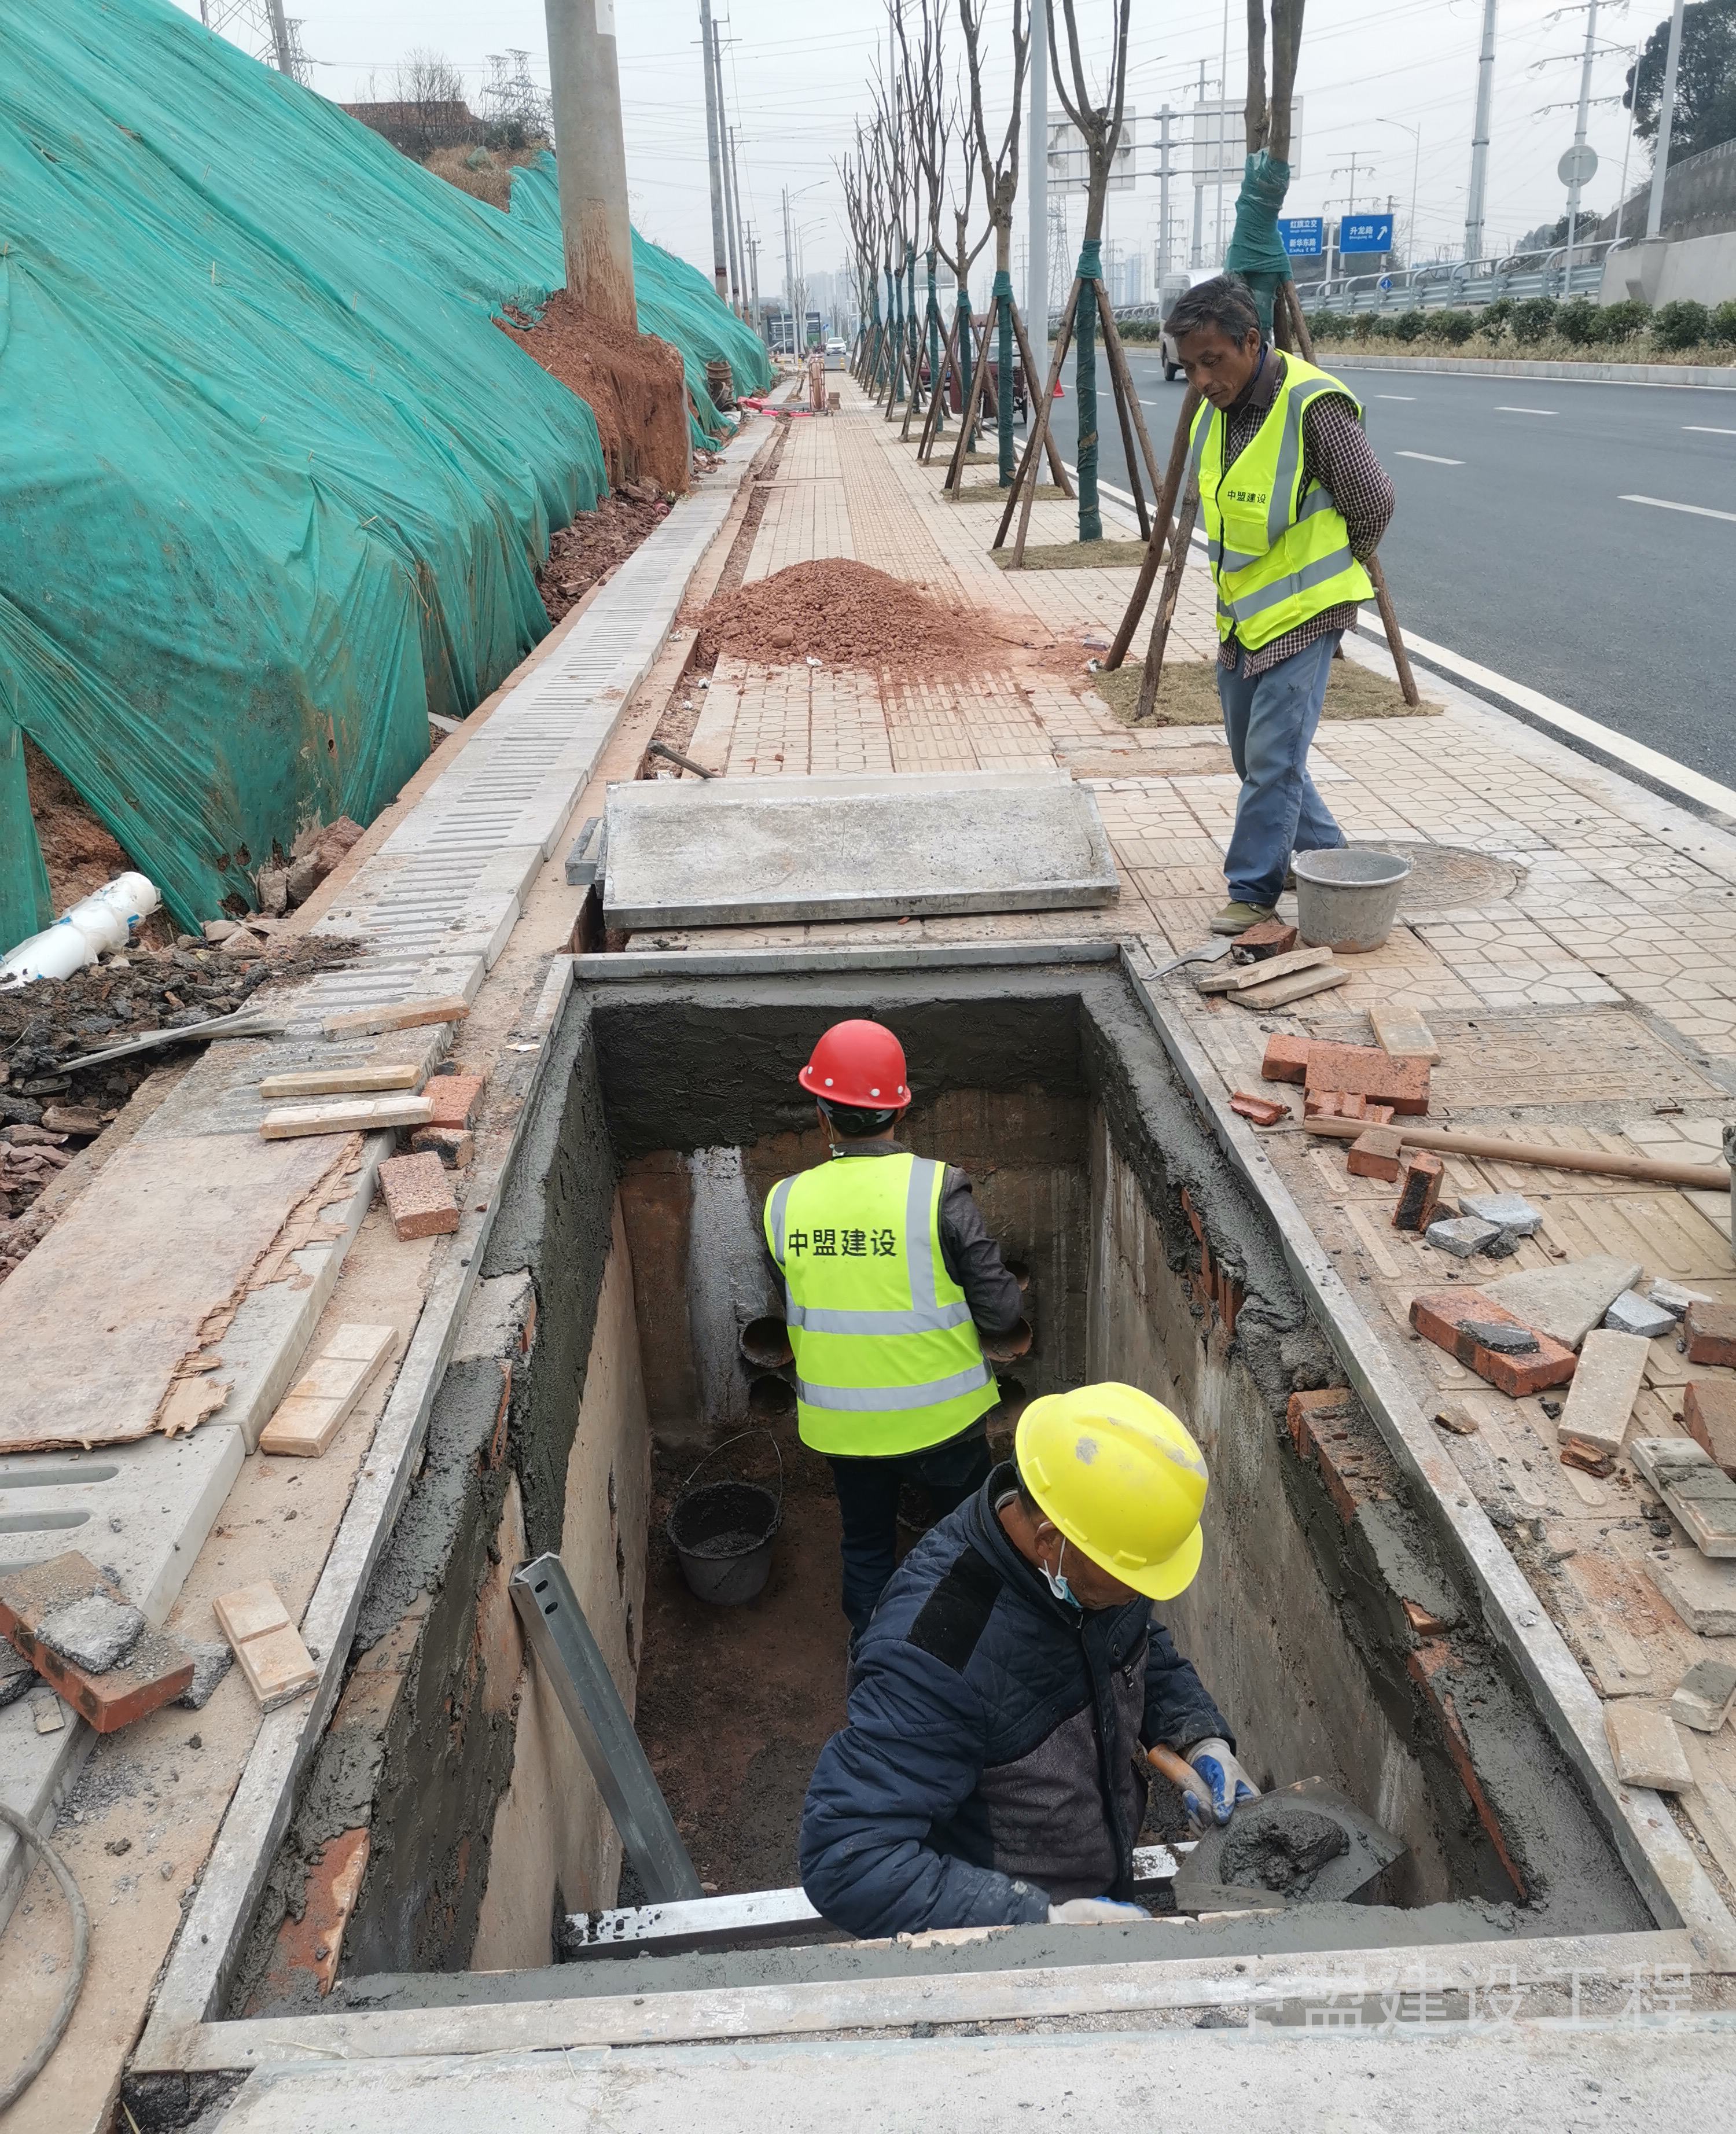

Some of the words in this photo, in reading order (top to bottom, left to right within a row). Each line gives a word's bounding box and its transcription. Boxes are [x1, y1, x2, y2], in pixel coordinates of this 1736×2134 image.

[1349, 226, 1373, 235] 升龙路
[1289, 238, 1316, 247] 新华东路
[1227, 490, 1267, 504] 中盟建设
[788, 1228, 897, 1257] 中盟建设
